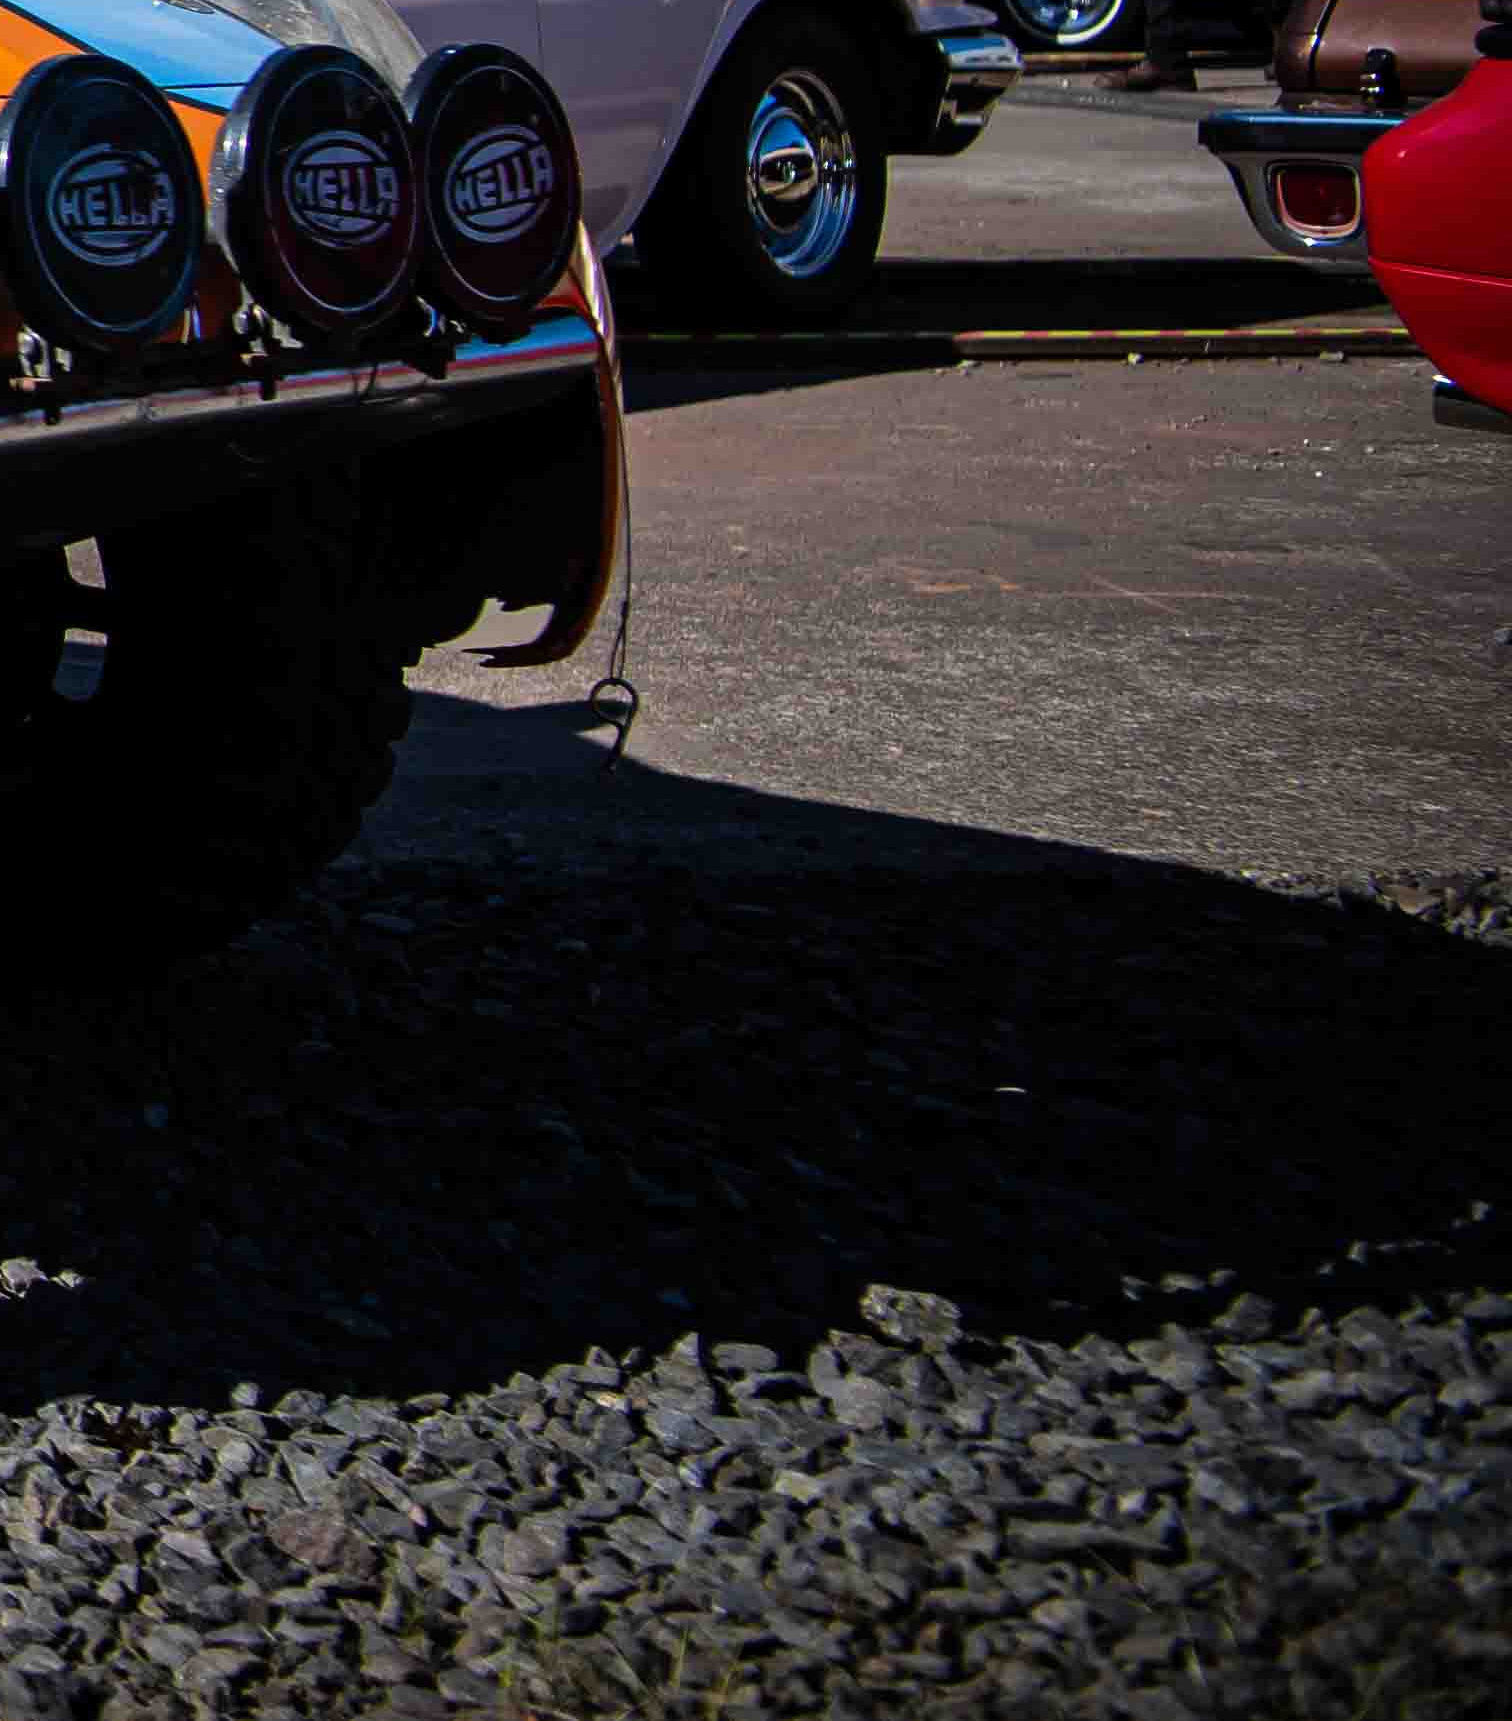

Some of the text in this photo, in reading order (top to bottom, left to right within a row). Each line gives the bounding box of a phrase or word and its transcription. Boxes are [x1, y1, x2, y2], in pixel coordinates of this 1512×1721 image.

[63, 181, 175, 226] HELLA
[295, 165, 400, 216] HELLA
[455, 143, 554, 213] HELLA
